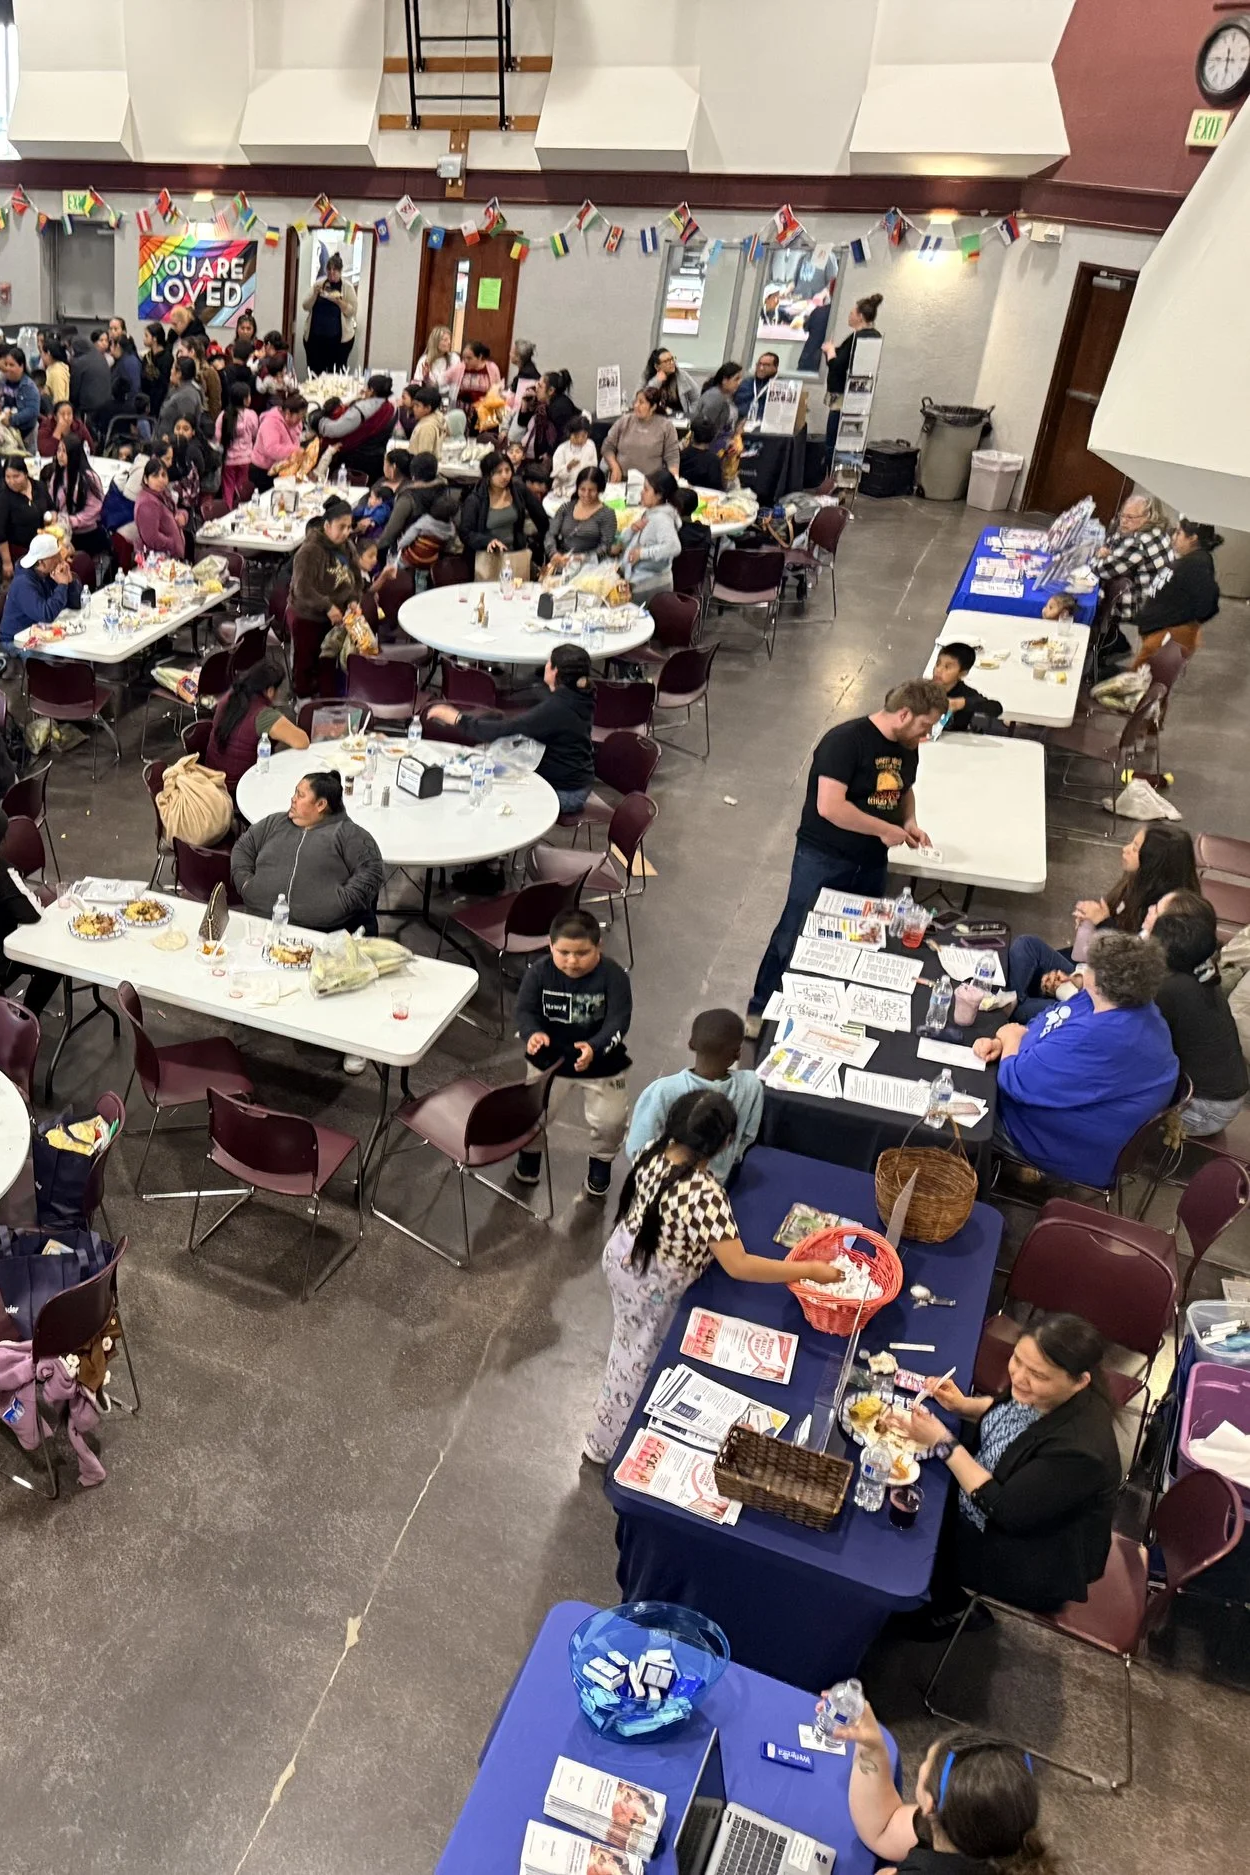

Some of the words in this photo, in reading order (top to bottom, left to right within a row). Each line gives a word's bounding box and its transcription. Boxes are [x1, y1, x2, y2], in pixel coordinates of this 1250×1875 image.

[1193, 115, 1224, 140] EXIT
[67, 194, 84, 210] EXI
[149, 253, 196, 277] YOU
[198, 257, 245, 280] ARE
[150, 277, 242, 308] LOVED
